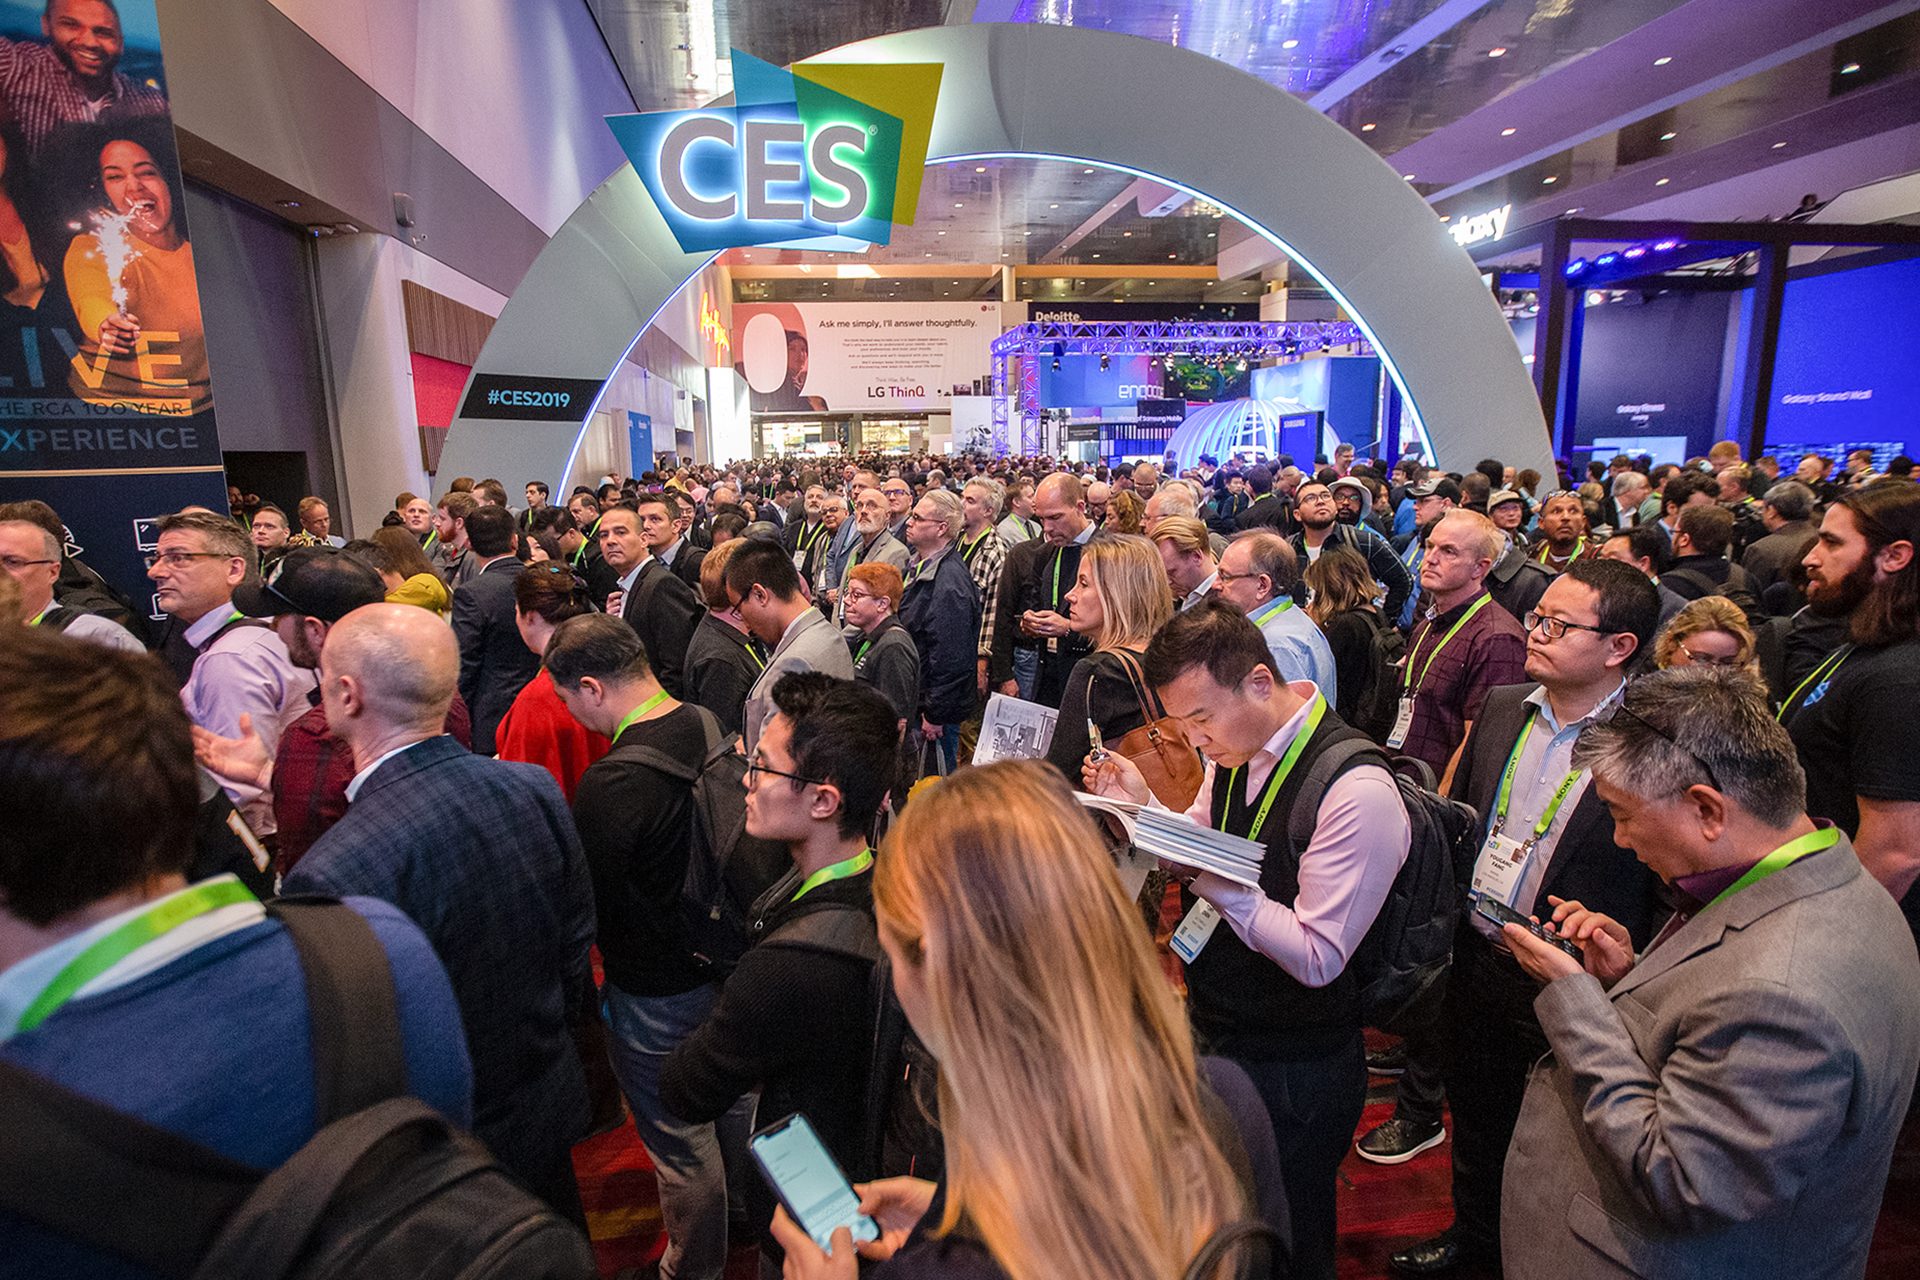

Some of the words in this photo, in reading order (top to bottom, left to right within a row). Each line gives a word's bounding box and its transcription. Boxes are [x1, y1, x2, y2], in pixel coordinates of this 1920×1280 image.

[659, 116, 868, 223] CES
[819, 320, 835, 328] Ask
[852, 320, 882, 329] simply,
[925, 319, 978, 329] thoughtfully.
[0, 327, 189, 389] IVE
[487, 389, 571, 408] #CES2019
[867, 386, 885, 398] LG
[888, 385, 925, 398] ThinQ
[32, 402, 73, 415] RCA
[86, 402, 126, 415] 100
[134, 402, 184, 414] YEAR
[1506, 755, 1518, 780] SONY
[1556, 776, 1574, 800] SONY
[1253, 807, 1266, 834] SONY
